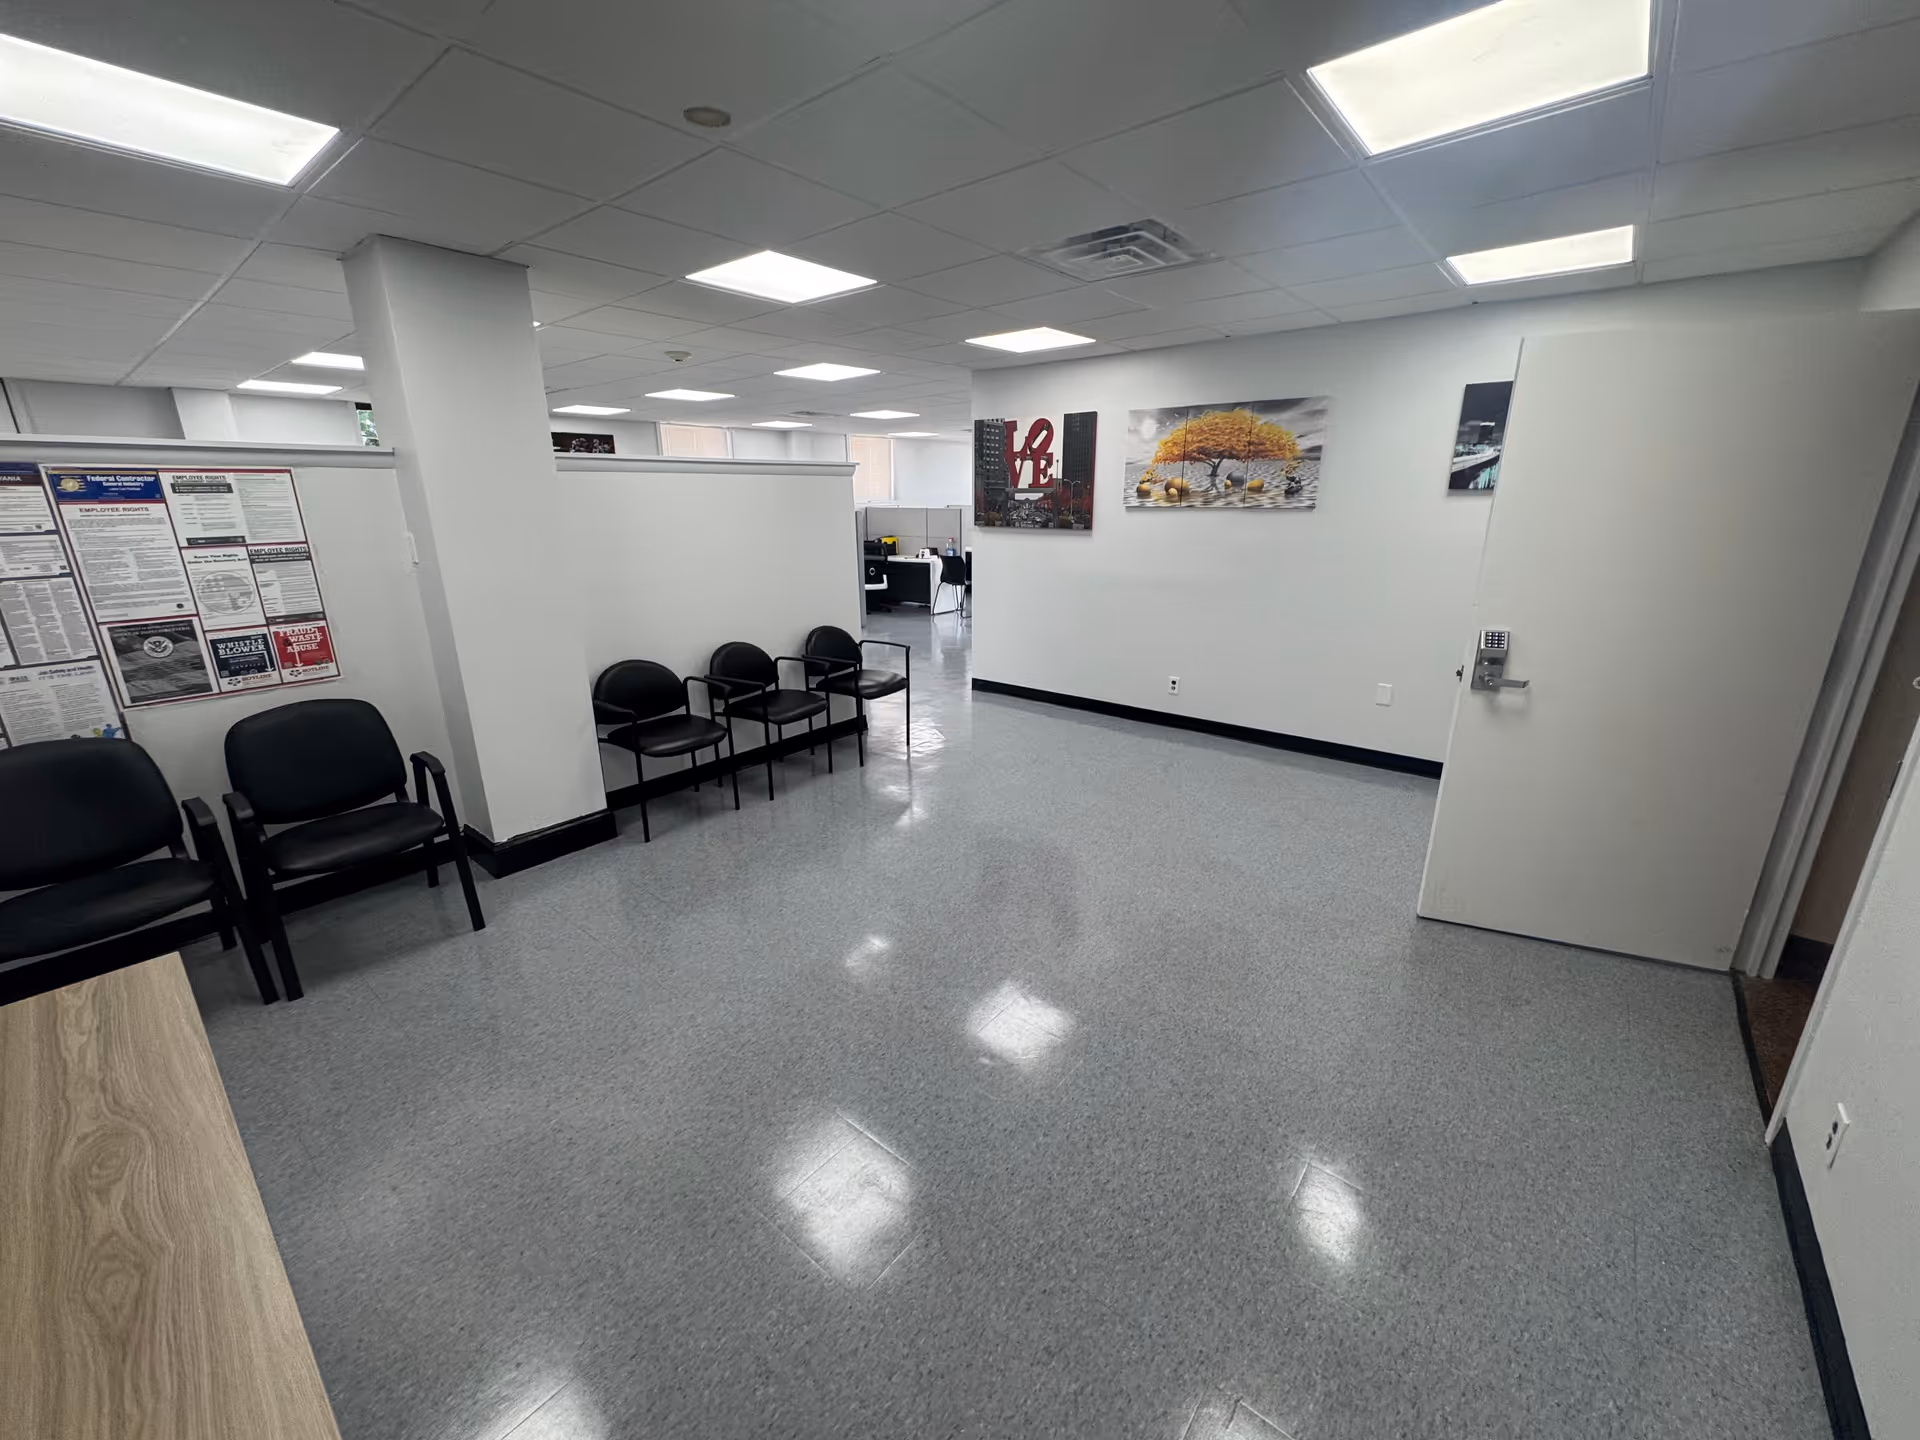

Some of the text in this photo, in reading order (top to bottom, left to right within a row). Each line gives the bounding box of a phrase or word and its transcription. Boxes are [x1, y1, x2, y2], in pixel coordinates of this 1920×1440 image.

[279, 627, 315, 637] FRAUD
[288, 633, 323, 643] WASTE
[216, 638, 265, 650] WHISTLE
[287, 642, 319, 653] ABUSE
[218, 644, 266, 656] BLOWER
